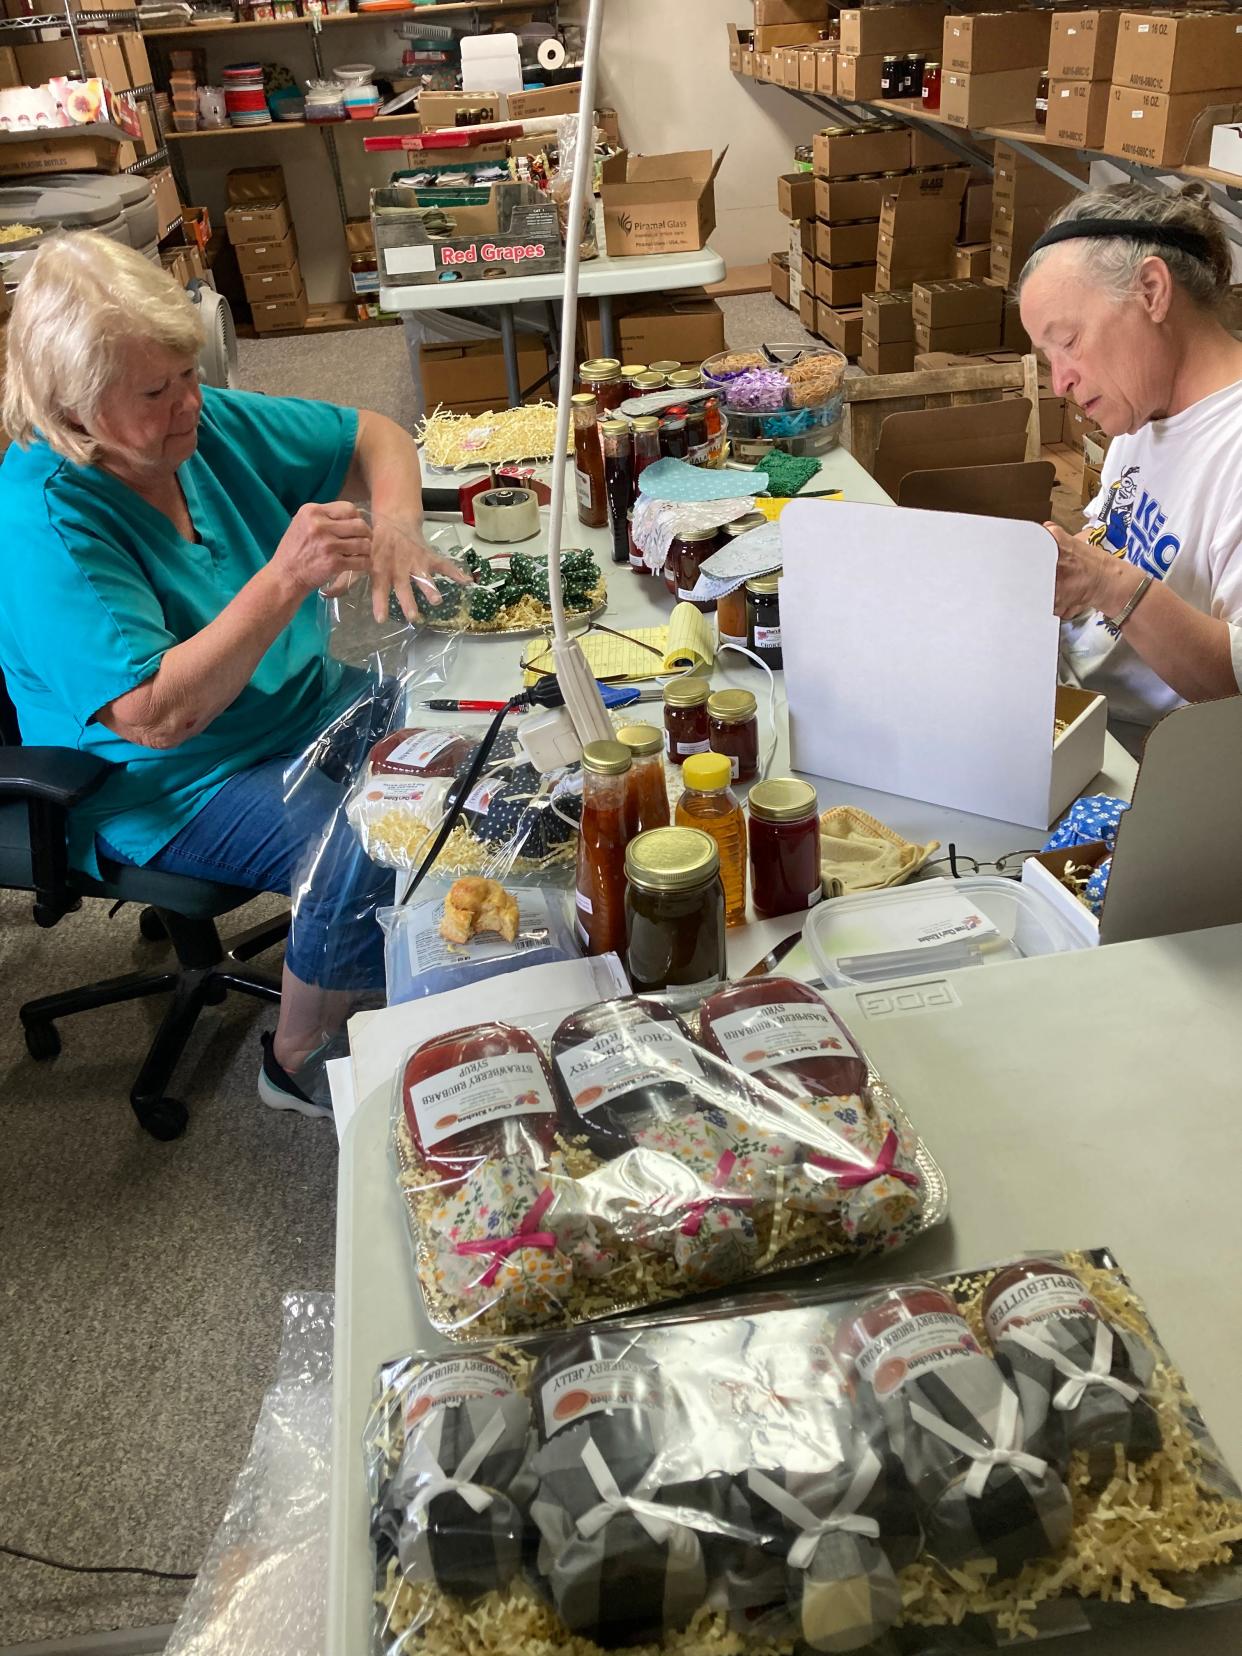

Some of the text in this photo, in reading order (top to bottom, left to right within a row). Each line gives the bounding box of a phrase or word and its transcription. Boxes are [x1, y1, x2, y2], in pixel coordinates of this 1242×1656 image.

[634, 219, 688, 231] Piramal Glass
[441, 243, 546, 265] Red Grapes
[723, 1020, 772, 1041] RHUBARB
[459, 1058, 489, 1078] SYRUP
[469, 1063, 534, 1087] STRAWBERRY
[421, 1081, 468, 1105] RHUBARB
[457, 1102, 513, 1123] Char's Kitchen
[874, 1321, 917, 1354] RHUBAB
[907, 1346, 970, 1370] Char's Kitchen
[553, 1367, 585, 1392] JELLY
